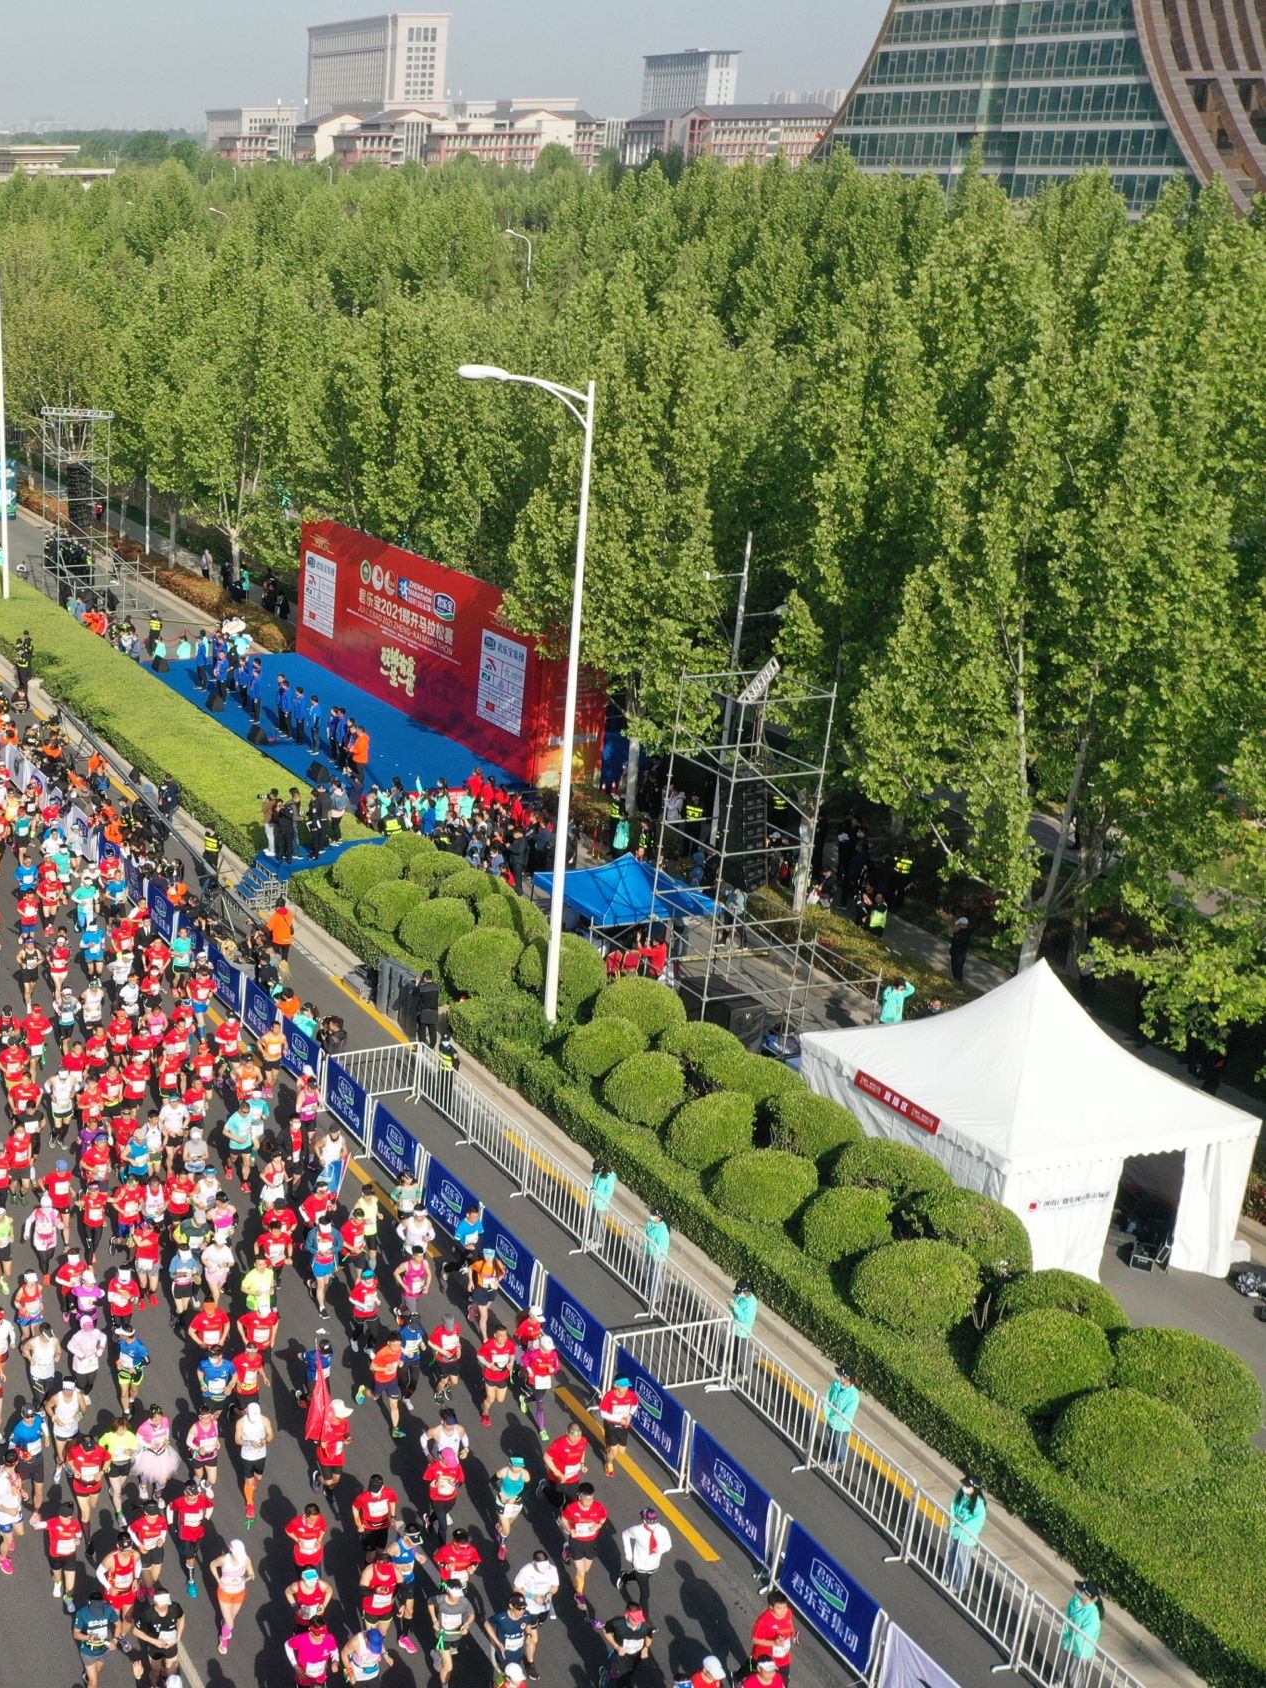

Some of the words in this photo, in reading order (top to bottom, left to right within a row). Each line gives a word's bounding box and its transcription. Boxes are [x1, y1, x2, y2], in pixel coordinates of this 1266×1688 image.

[358, 588, 454, 645] 君乐宝2021郑开马拉松赛
[422, 634, 453, 655] MARATHON
[563, 1305, 585, 1331] 君乐宝
[549, 1316, 594, 1372] 君乐宝集团
[638, 1380, 663, 1408] 君乐宝
[718, 1464, 743, 1494] 君乐宝
[700, 1472, 758, 1542] 君乐宝集团
[816, 1563, 845, 1598] 君乐宝
[790, 1571, 860, 1653] 君乐宝集团
